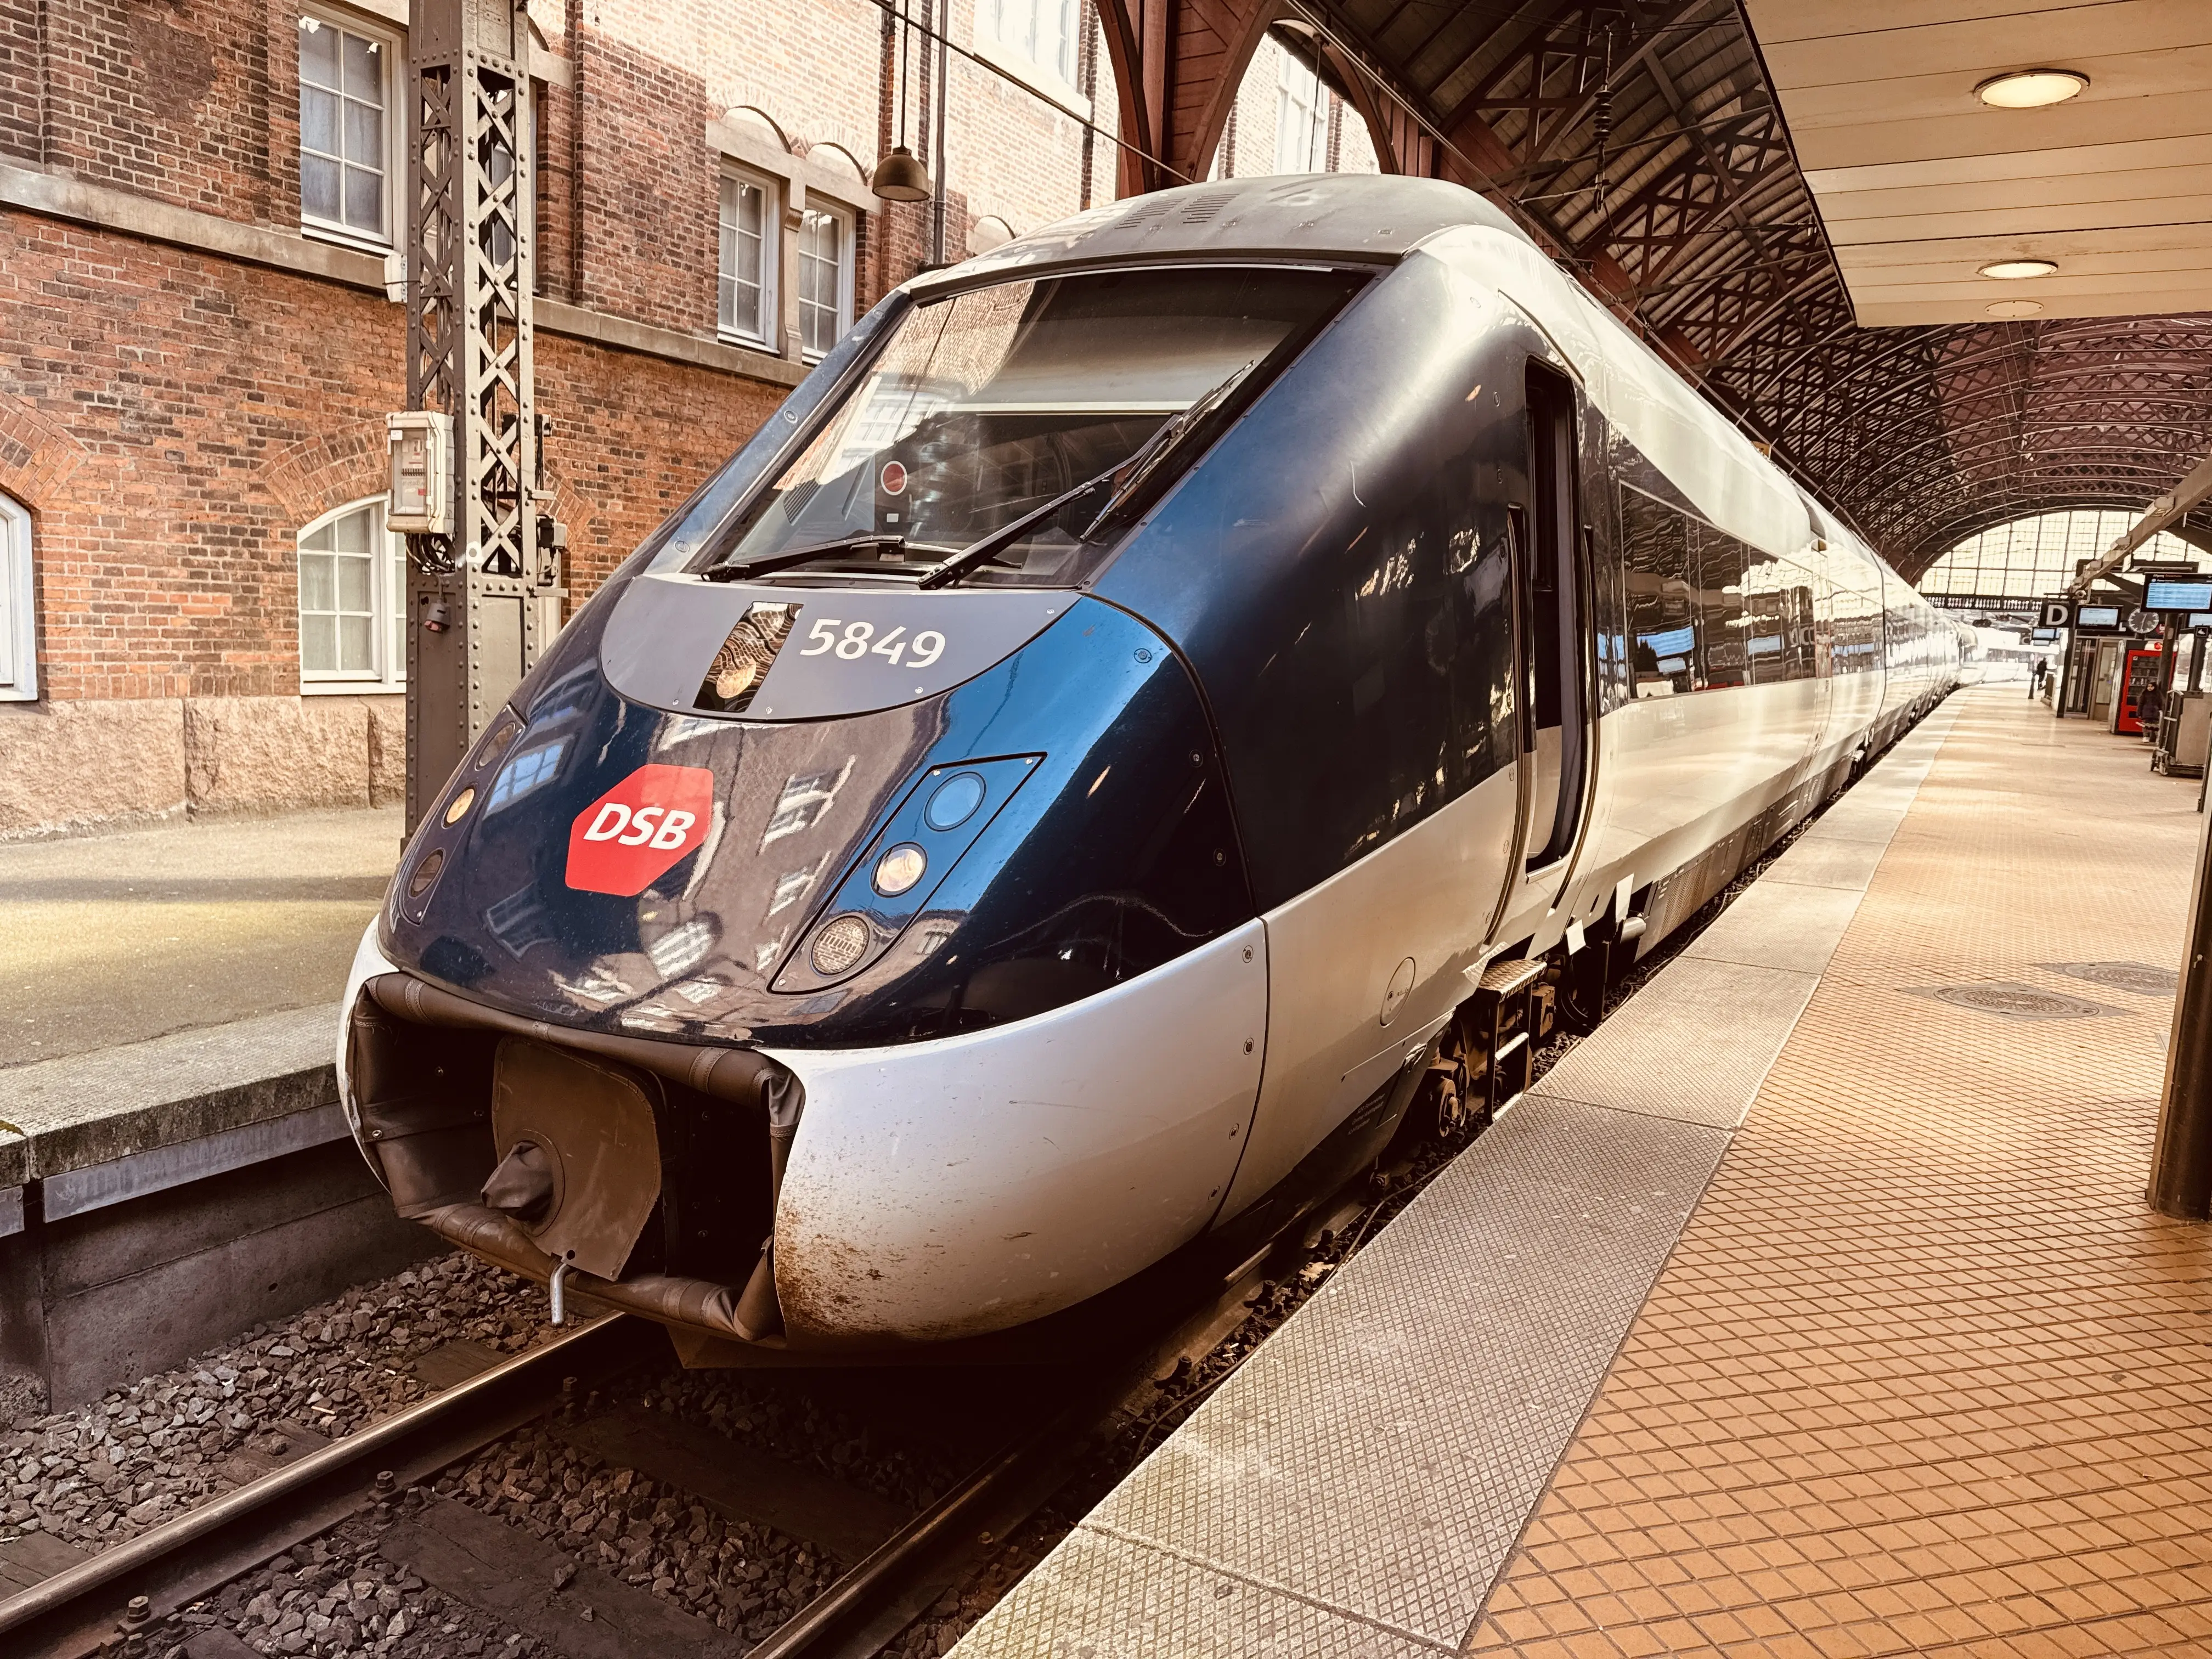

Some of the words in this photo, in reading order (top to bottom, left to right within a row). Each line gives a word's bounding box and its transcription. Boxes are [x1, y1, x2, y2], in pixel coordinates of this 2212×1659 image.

[2046, 604, 2068, 625] D
[800, 618, 946, 668] 5849
[583, 802, 696, 850] DSB
